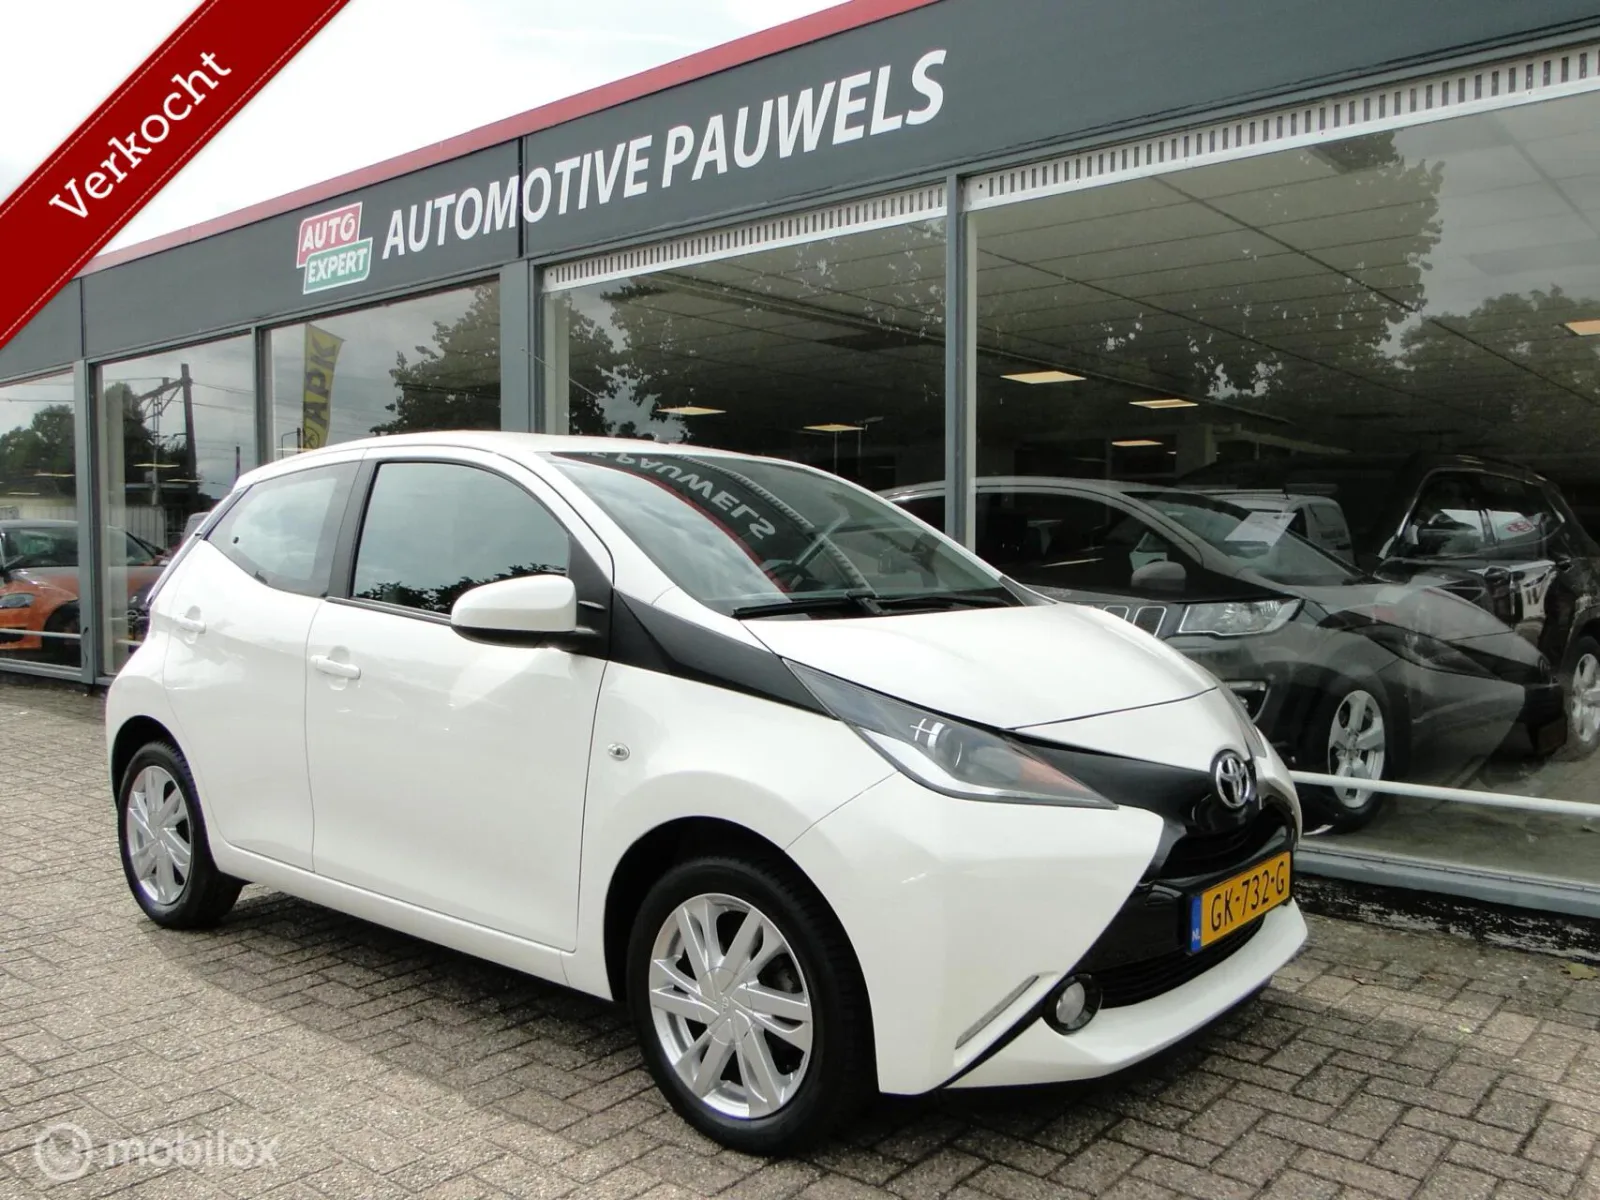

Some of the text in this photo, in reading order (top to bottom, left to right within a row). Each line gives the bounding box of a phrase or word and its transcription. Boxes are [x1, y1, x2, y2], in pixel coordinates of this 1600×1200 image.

[382, 49, 947, 260] AUTOMOTIVE PAUWELS
[301, 213, 356, 253] AUTO
[307, 248, 368, 284] EXPERT
[303, 334, 337, 430] APK
[1210, 860, 1285, 933] GK-732-G
